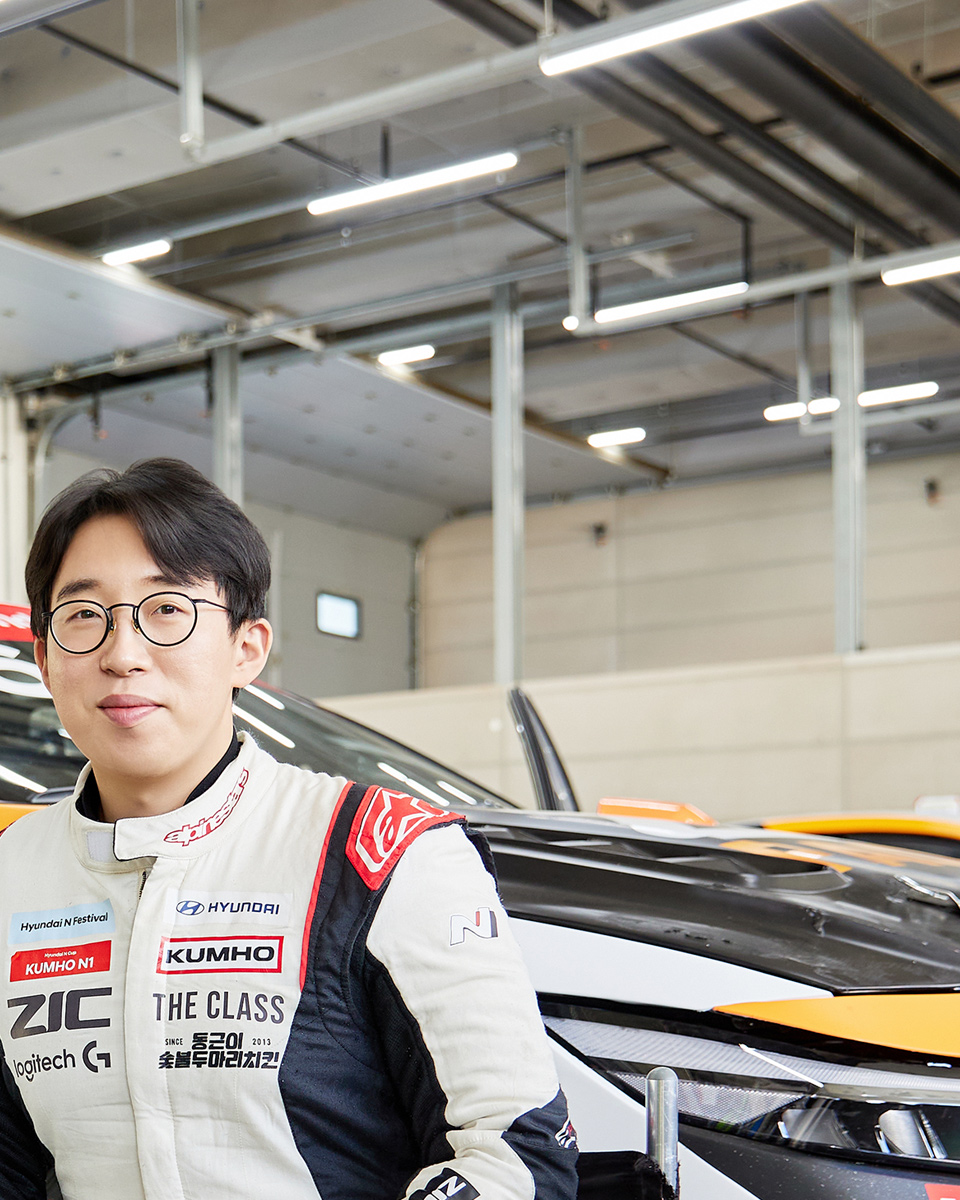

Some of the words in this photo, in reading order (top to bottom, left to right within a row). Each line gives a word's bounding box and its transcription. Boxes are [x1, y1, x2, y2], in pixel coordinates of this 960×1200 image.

[208, 901, 280, 915] HYUNDAI
[20, 918, 62, 932] Hyundai
[64, 917, 71, 927] N
[73, 912, 108, 925] Festival
[165, 946, 275, 964] KUMHO
[25, 959, 77, 976] KUMHO
[77, 956, 94, 971] N1
[7, 987, 112, 1039] ZIC
[153, 991, 197, 1021] THE
[207, 990, 285, 1025] CLASS
[165, 1038, 183, 1046] SINCE
[192, 1031, 243, 1050] 동근이
[252, 1038, 271, 1046] 2013
[13, 1049, 76, 1082] logitech
